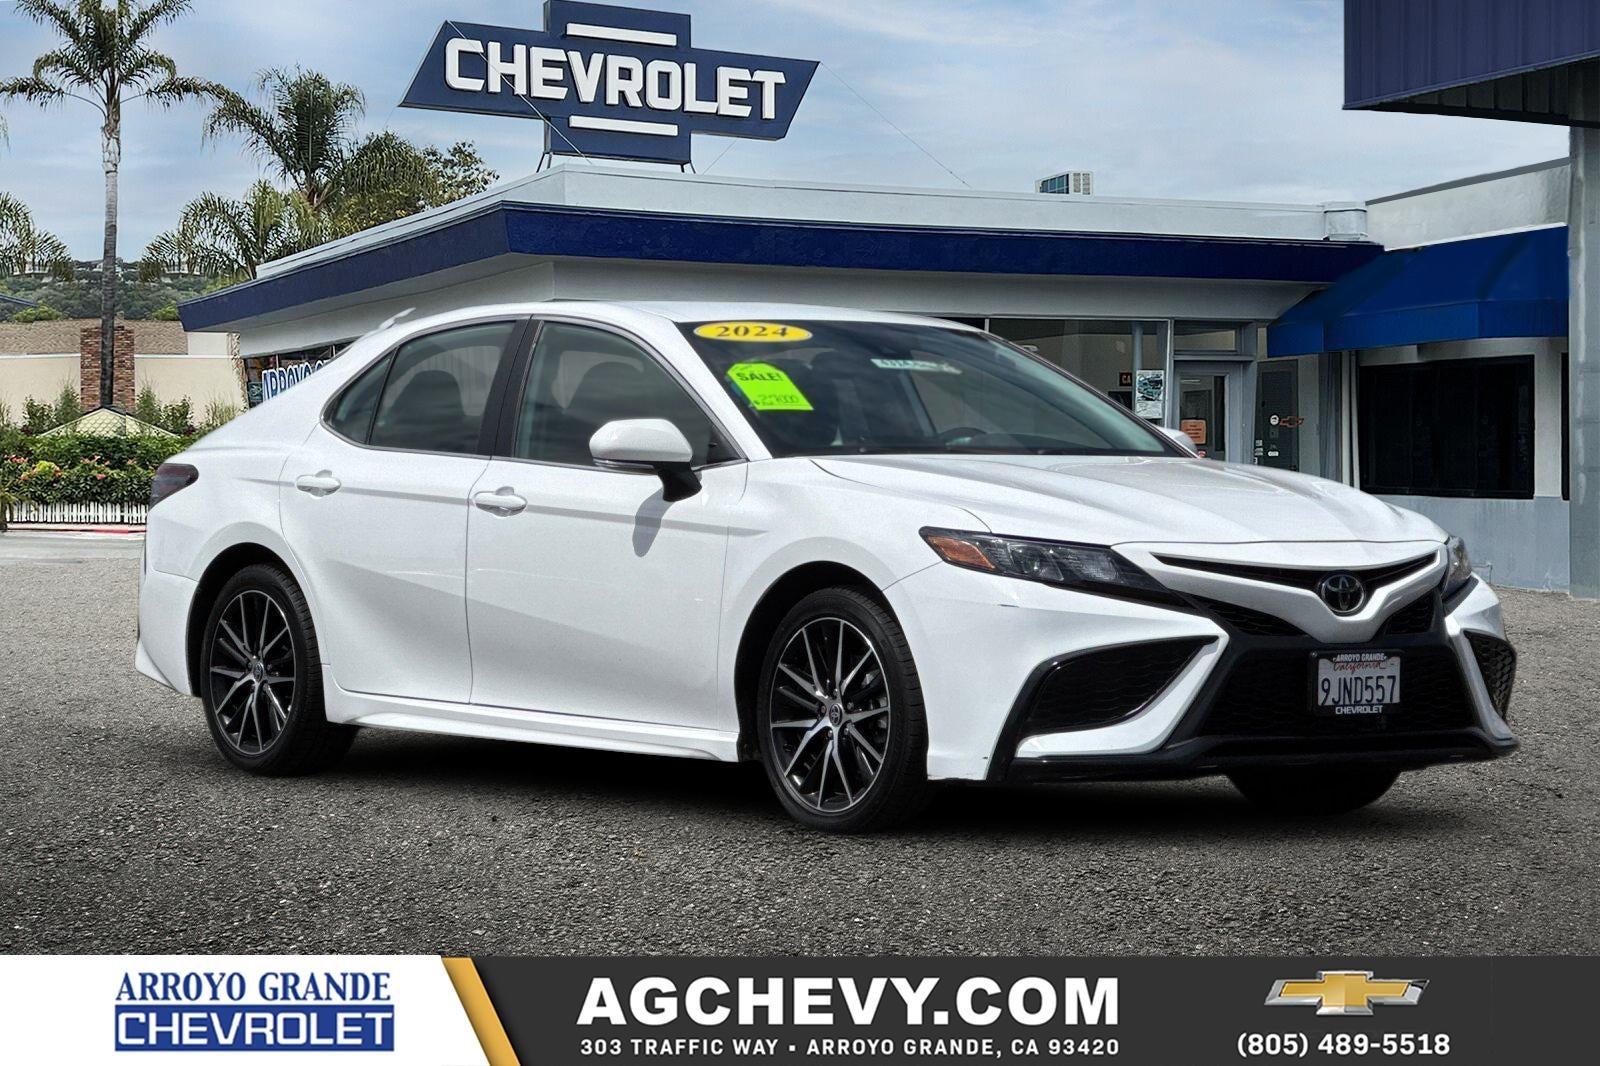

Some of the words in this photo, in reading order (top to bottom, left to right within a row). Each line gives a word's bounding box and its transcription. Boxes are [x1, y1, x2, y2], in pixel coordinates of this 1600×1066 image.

[445, 38, 785, 120] CHEVROLET
[716, 325, 789, 337] 2024
[735, 371, 785, 382] SALE!
[1337, 653, 1360, 661] ARROYO
[1321, 675, 1396, 705] 9JND557
[1335, 705, 1383, 714] CHEVROLET
